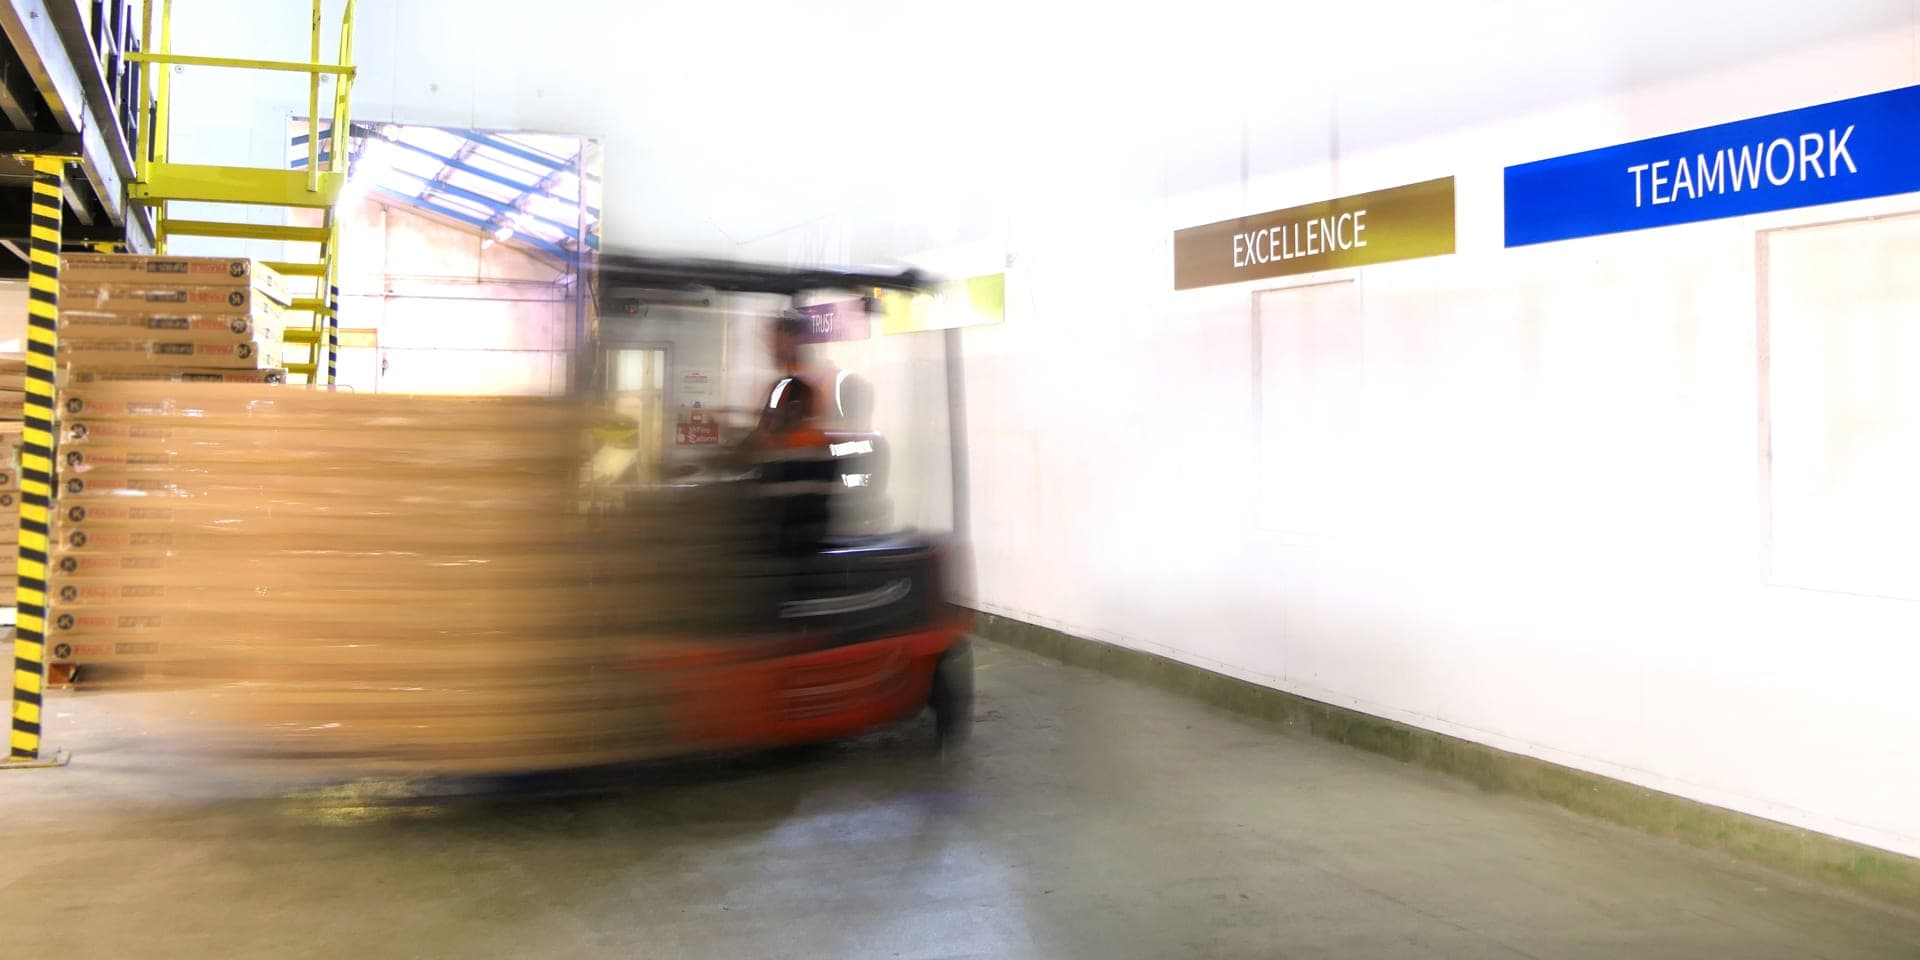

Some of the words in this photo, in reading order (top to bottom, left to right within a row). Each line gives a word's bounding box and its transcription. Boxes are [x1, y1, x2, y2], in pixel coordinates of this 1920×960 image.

[1627, 125, 1858, 208] TEAMWORK
[1233, 210, 1368, 269] EXCELLENCE
[811, 312, 834, 336] TRUST
